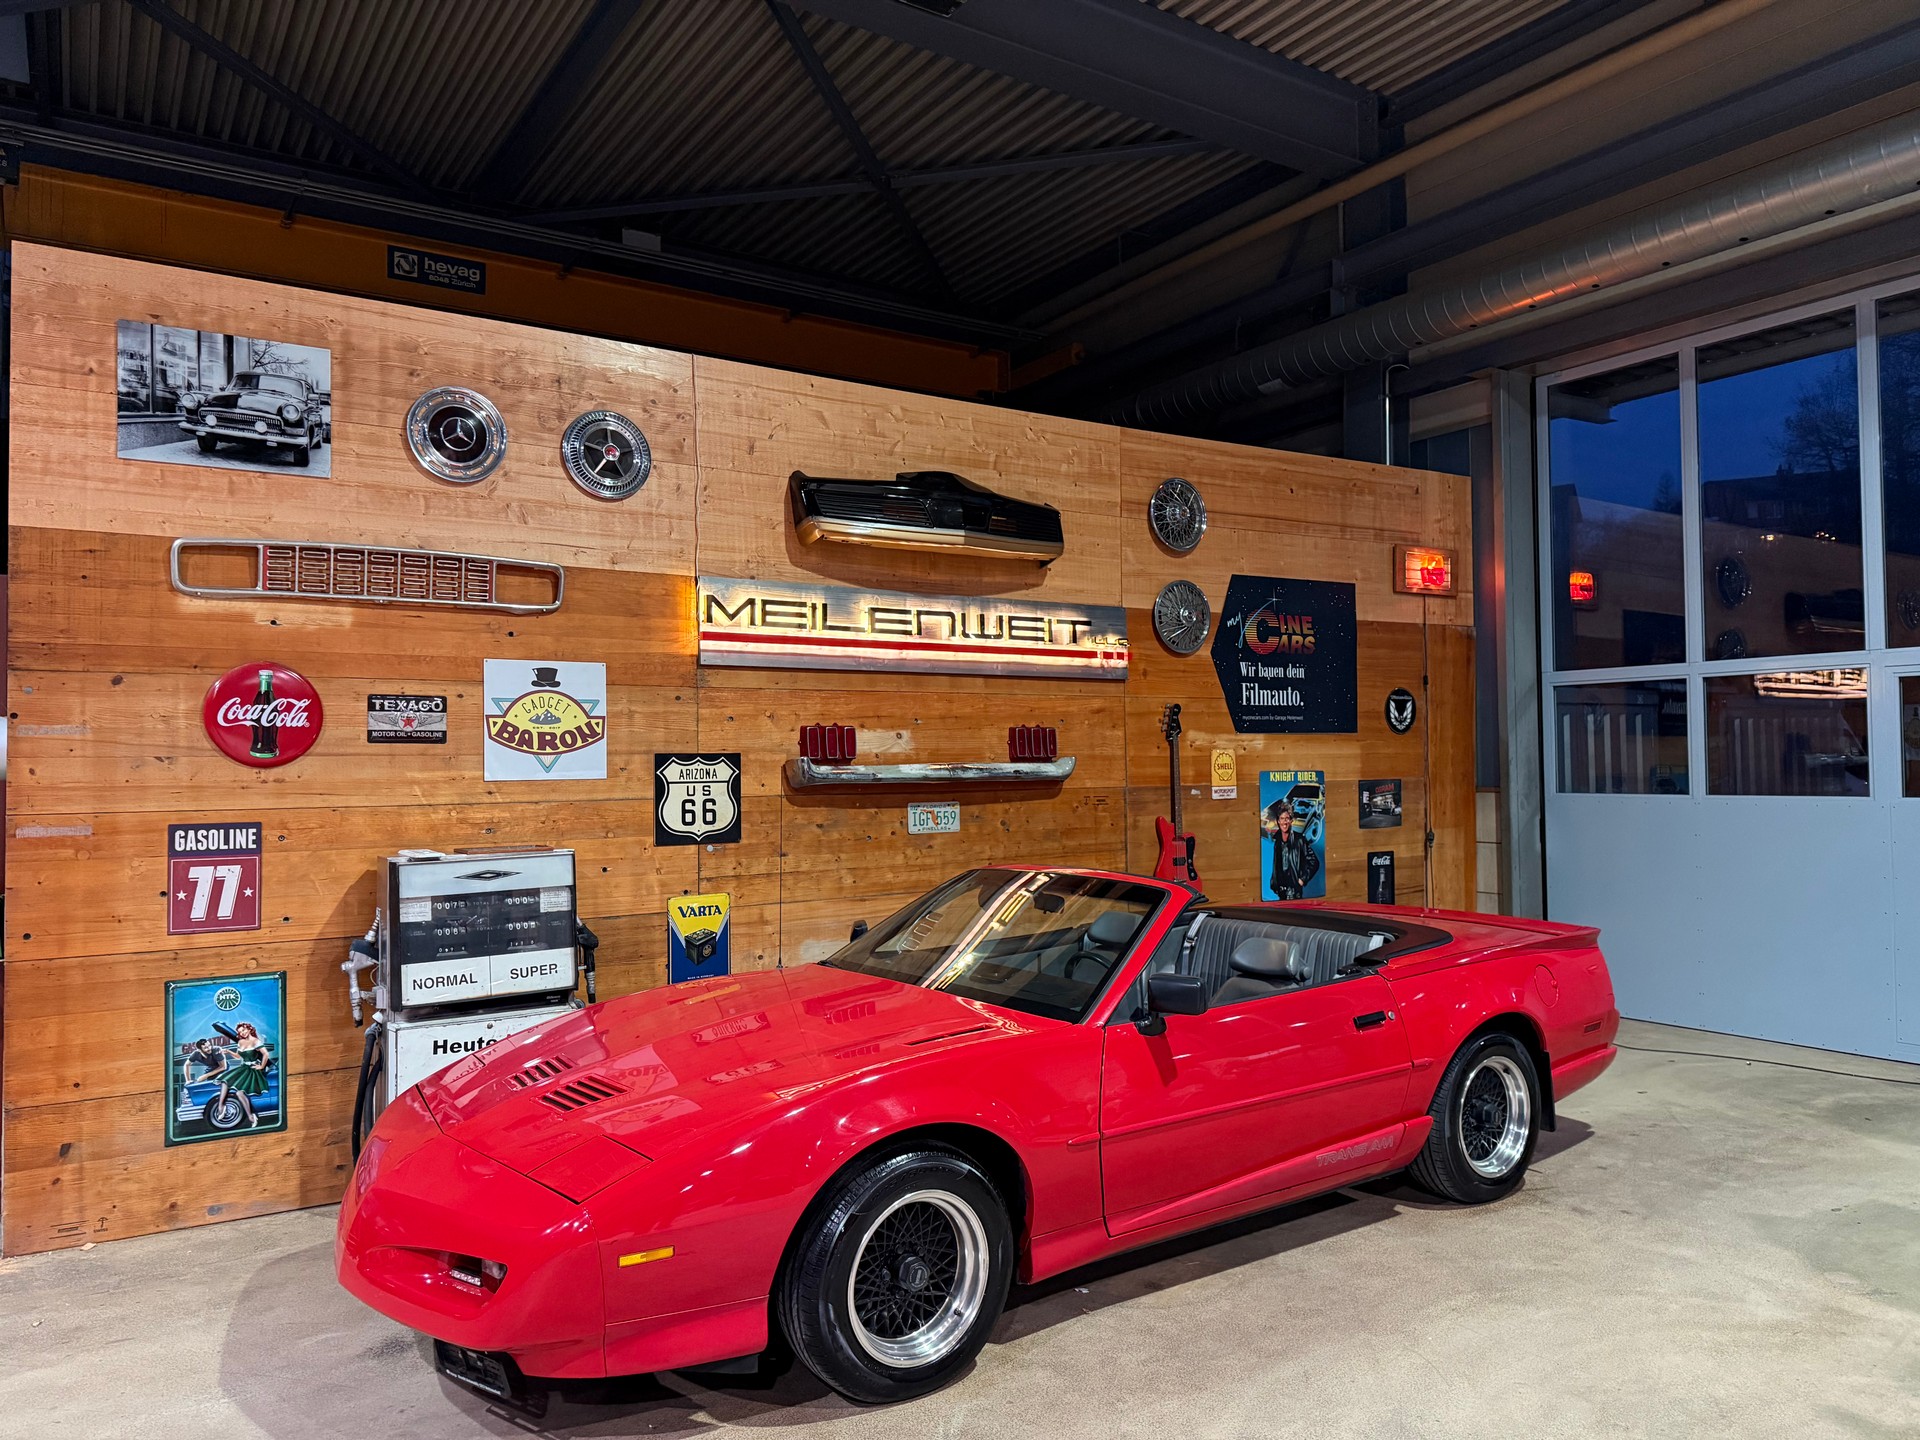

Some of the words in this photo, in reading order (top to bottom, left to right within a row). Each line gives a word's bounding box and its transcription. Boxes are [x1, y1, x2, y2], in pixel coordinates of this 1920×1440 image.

[424, 257, 480, 282] hevag
[704, 594, 1092, 644] MEILENWEIT
[1227, 611, 1244, 649] my
[1240, 661, 1256, 678] Wir
[1258, 662, 1284, 679] bauen
[1286, 663, 1305, 679] dein
[1240, 682, 1304, 707] Filmauto.
[372, 699, 443, 712] TEXACO
[521, 696, 572, 714] GADGET
[493, 719, 601, 751] BARON
[679, 768, 718, 780] ARIZONA
[1217, 762, 1233, 770] SHELL
[1269, 771, 1295, 782] KNIGHT
[681, 798, 717, 826] 66
[174, 828, 257, 851] GASOLINE
[188, 865, 243, 921] 77
[677, 904, 723, 918] VARTA
[510, 963, 558, 980] SUPER
[412, 972, 478, 990] NORMAL
